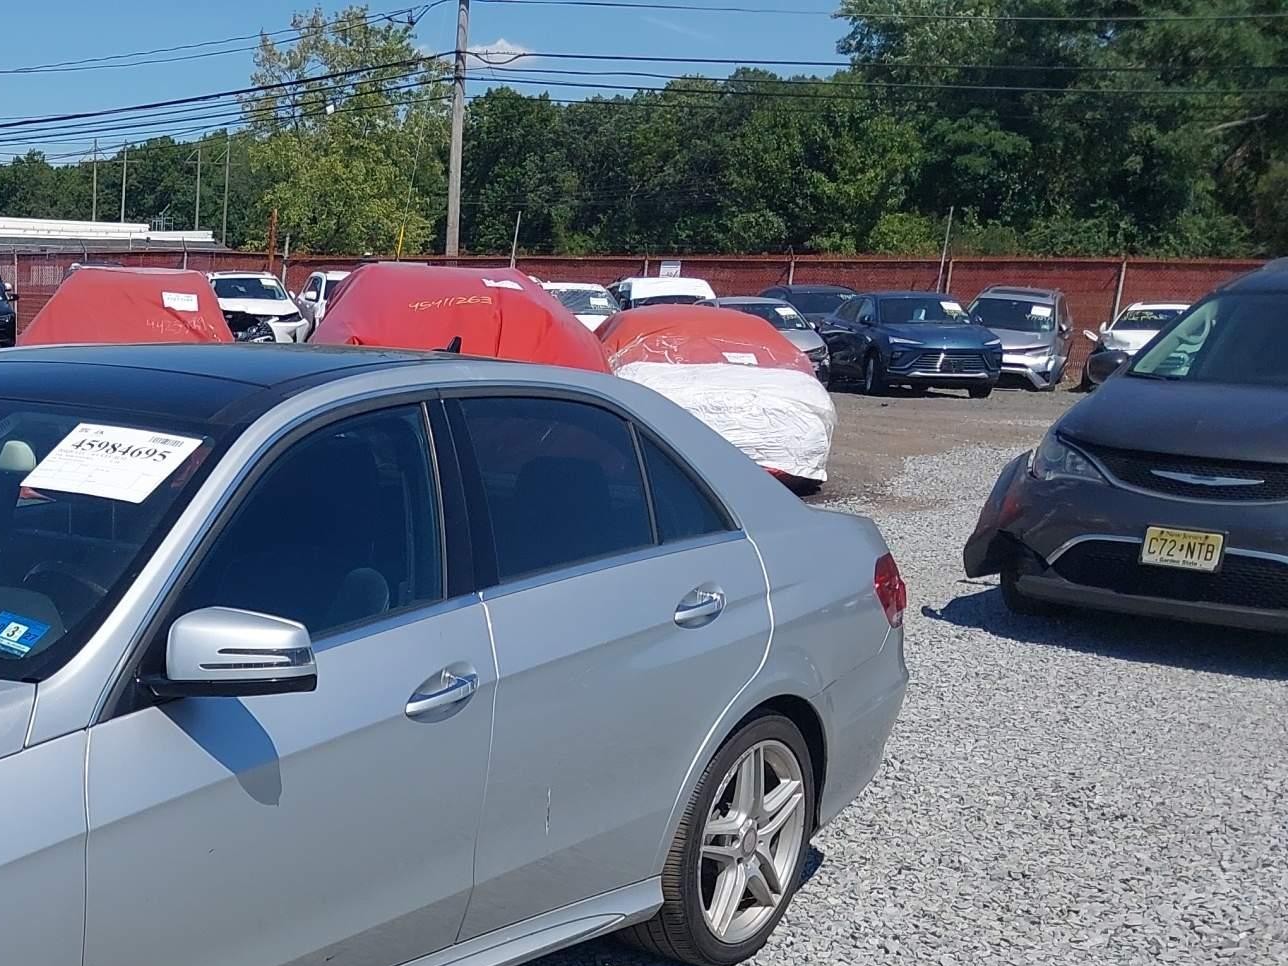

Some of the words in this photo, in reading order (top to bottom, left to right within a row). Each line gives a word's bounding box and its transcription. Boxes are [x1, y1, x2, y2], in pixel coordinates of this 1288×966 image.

[72, 438, 172, 463] 45984695
[1148, 537, 1177, 557] C72
[1185, 542, 1215, 561] NTB
[6, 626, 19, 637] 3
